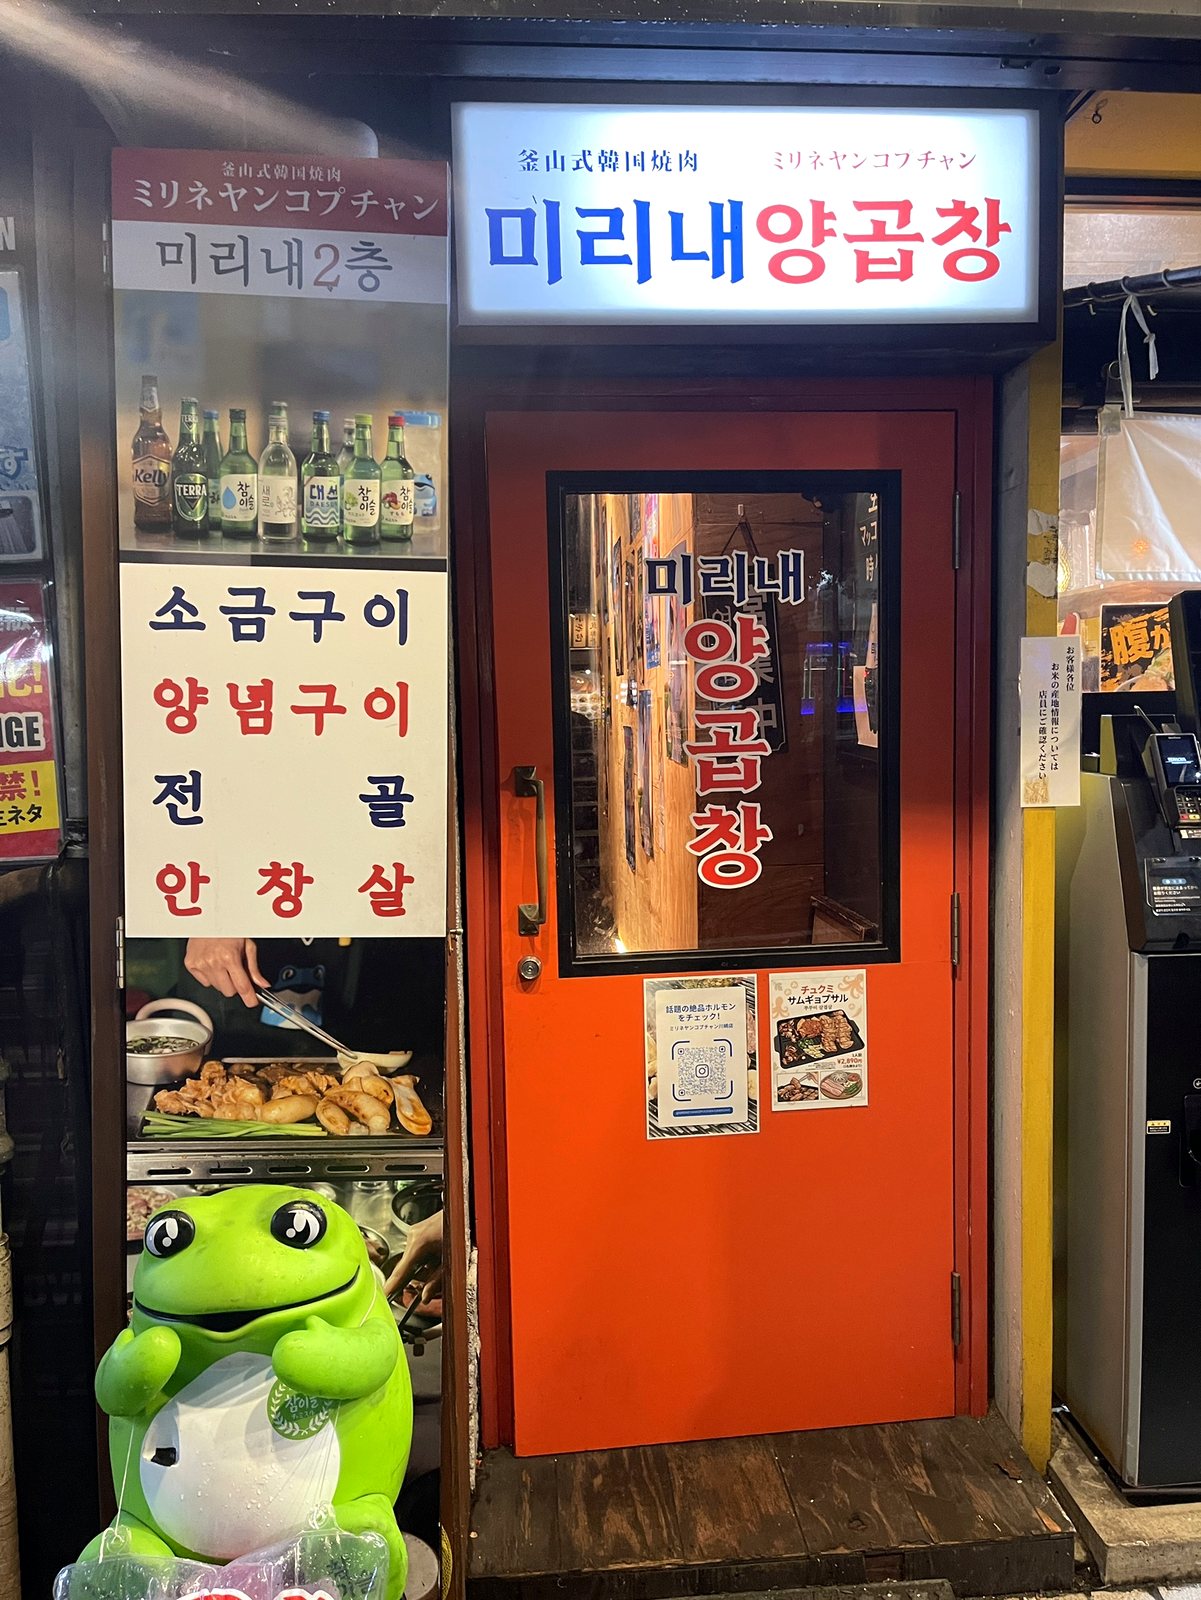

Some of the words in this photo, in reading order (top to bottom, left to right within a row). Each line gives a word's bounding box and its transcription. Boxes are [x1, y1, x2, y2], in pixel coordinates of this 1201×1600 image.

[222, 161, 341, 182] 釜山式韓国焼肉
[517, 149, 698, 172] 釜山式韓国焼肉
[133, 178, 439, 220] ミリネヤンコプチャン
[156, 231, 393, 292] 미리내2층
[135, 469, 167, 487] Kelly
[176, 484, 207, 497] TERRA
[309, 484, 338, 500] 대선
[358, 486, 376, 515] 참이슬
[644, 549, 805, 606] 미리내
[149, 586, 409, 645] 소금구이
[1066, 646, 1075, 692] お客様各位
[152, 677, 409, 738] 양념구이
[1050, 663, 1060, 771] お米の産地情報については
[0, 715, 41, 748] GE
[1038, 690, 1048, 779] 店員にご確認ください
[684, 612, 773, 888] 양곱창
[801, 984, 834, 995] チュクミ
[665, 1003, 736, 1014] 話題の絶品ホルモン
[678, 1013, 720, 1022] をチェック!
